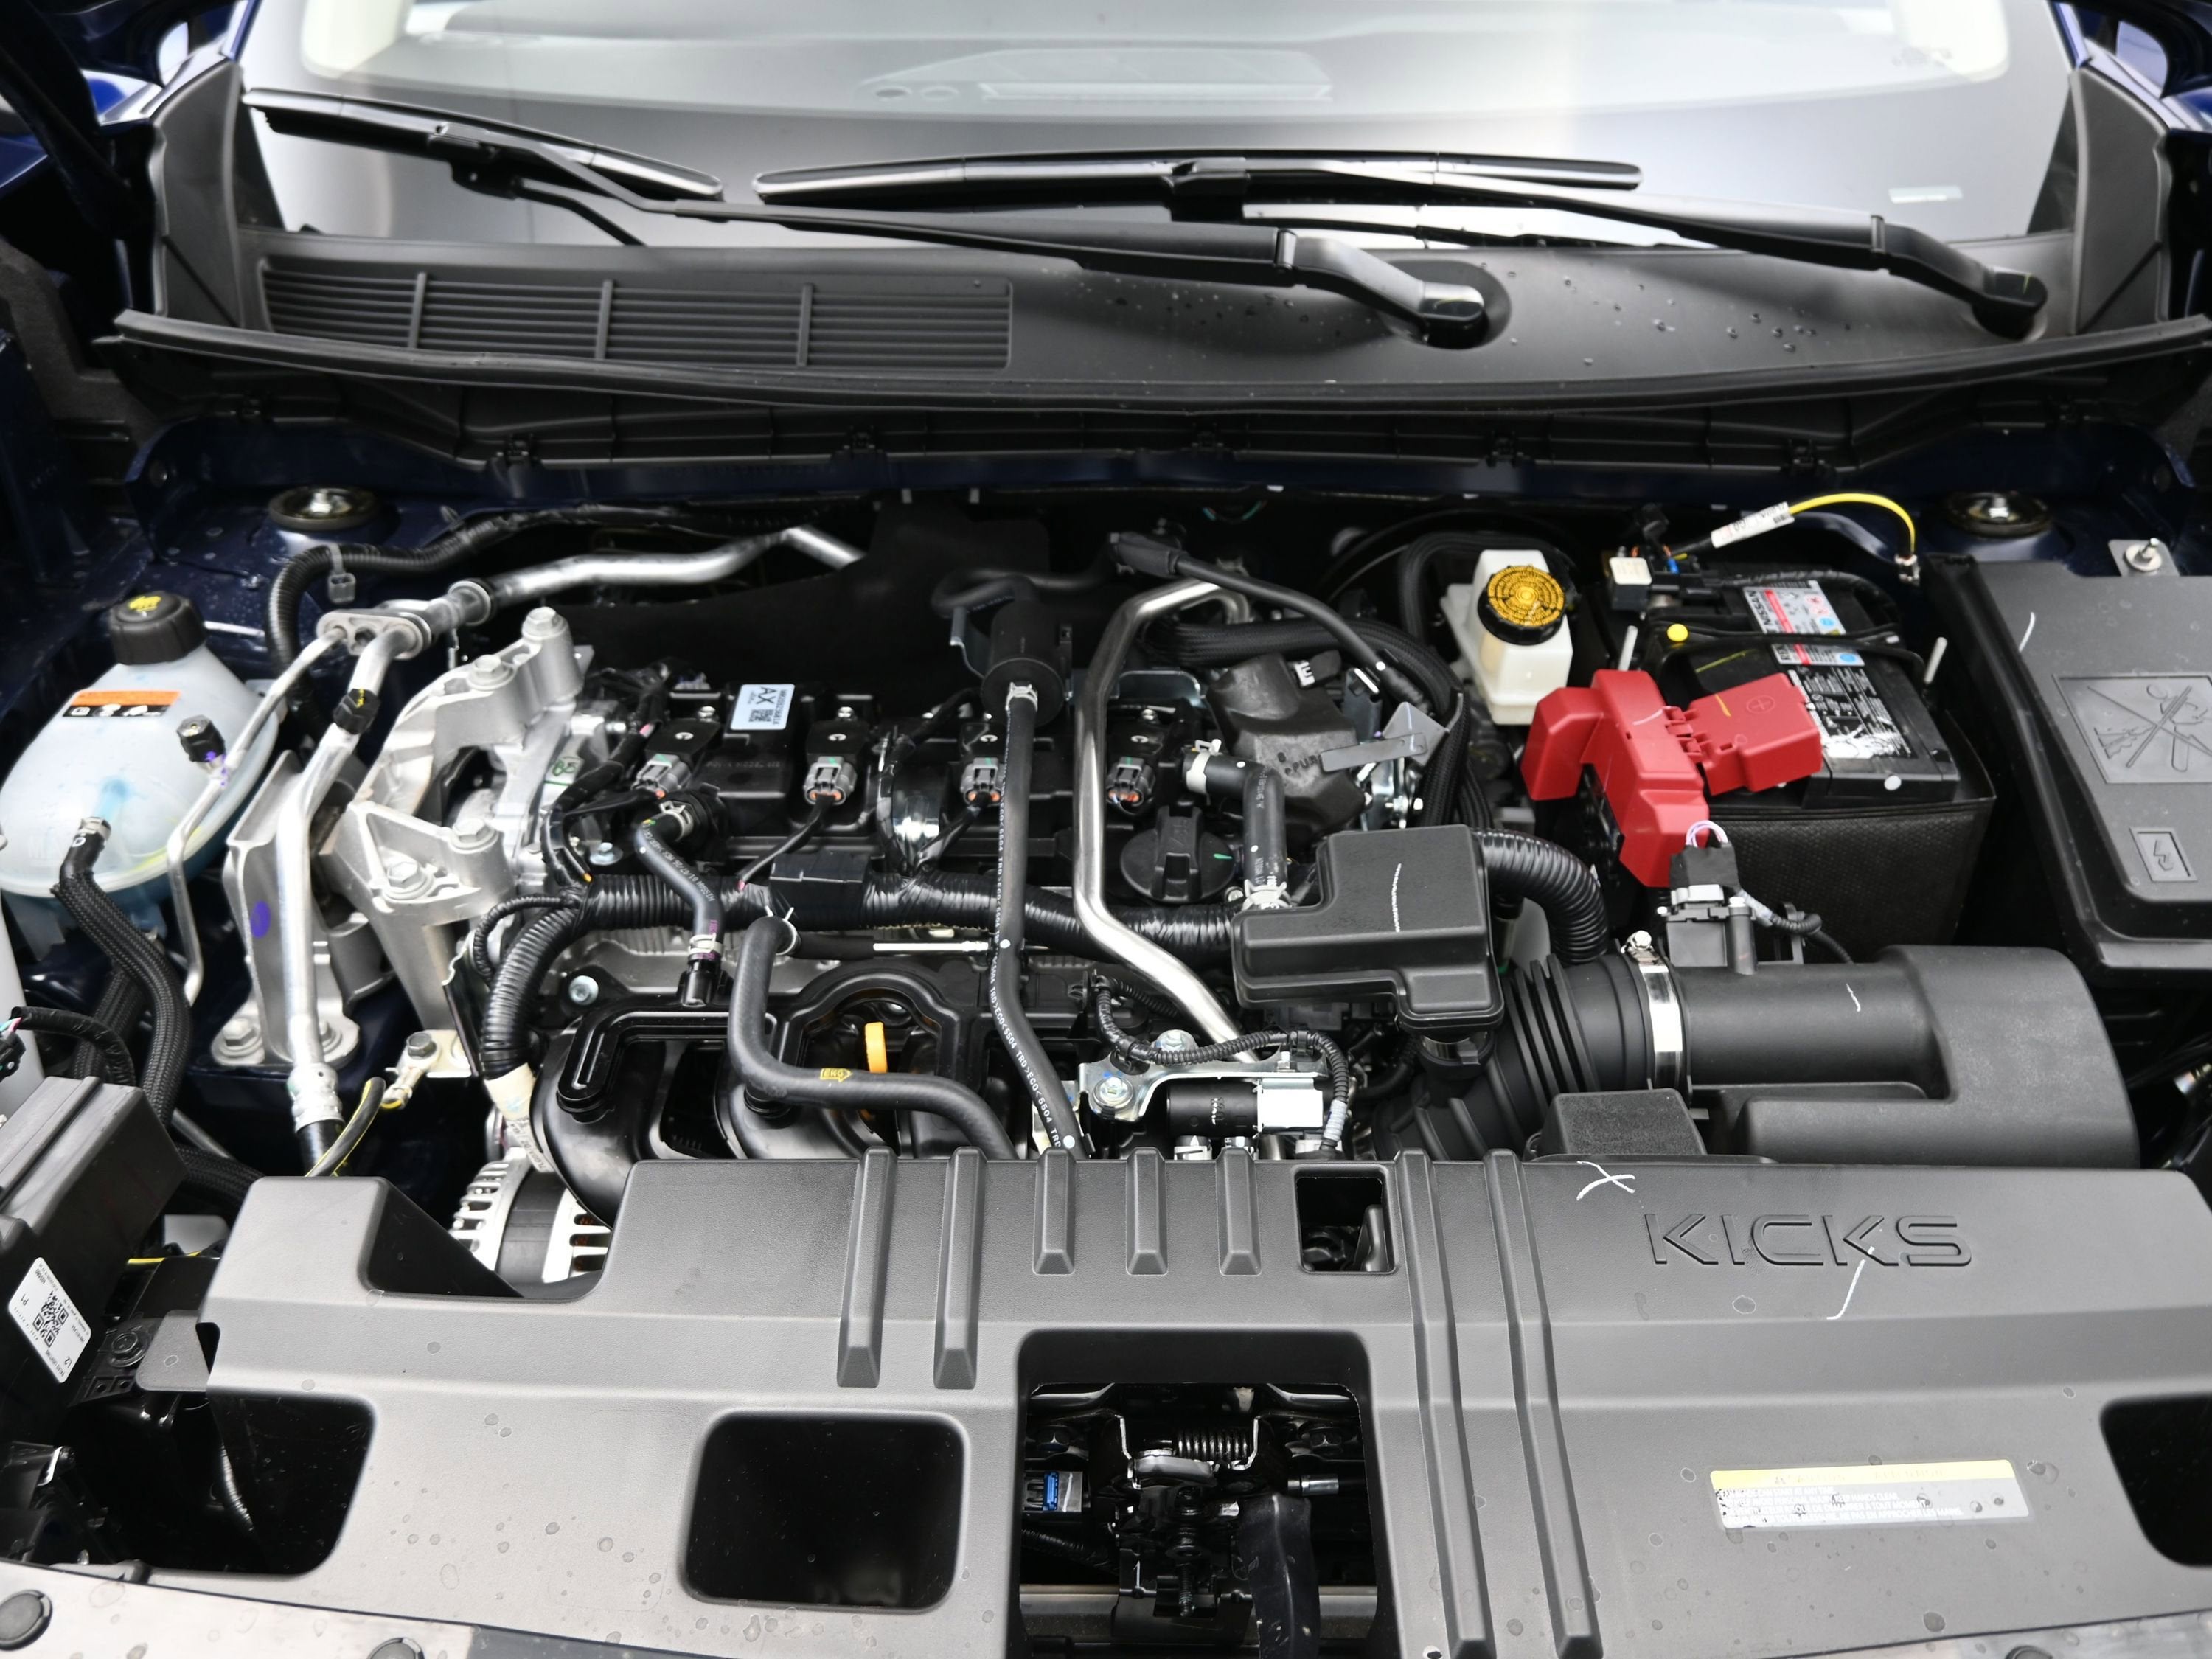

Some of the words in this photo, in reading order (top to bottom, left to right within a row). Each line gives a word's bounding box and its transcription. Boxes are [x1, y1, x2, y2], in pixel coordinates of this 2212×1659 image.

[1745, 590, 1771, 625] NISSAN
[757, 686, 777, 705] AX
[1644, 1214, 1972, 1266] KICKS
[21, 1294, 29, 1306] P1
